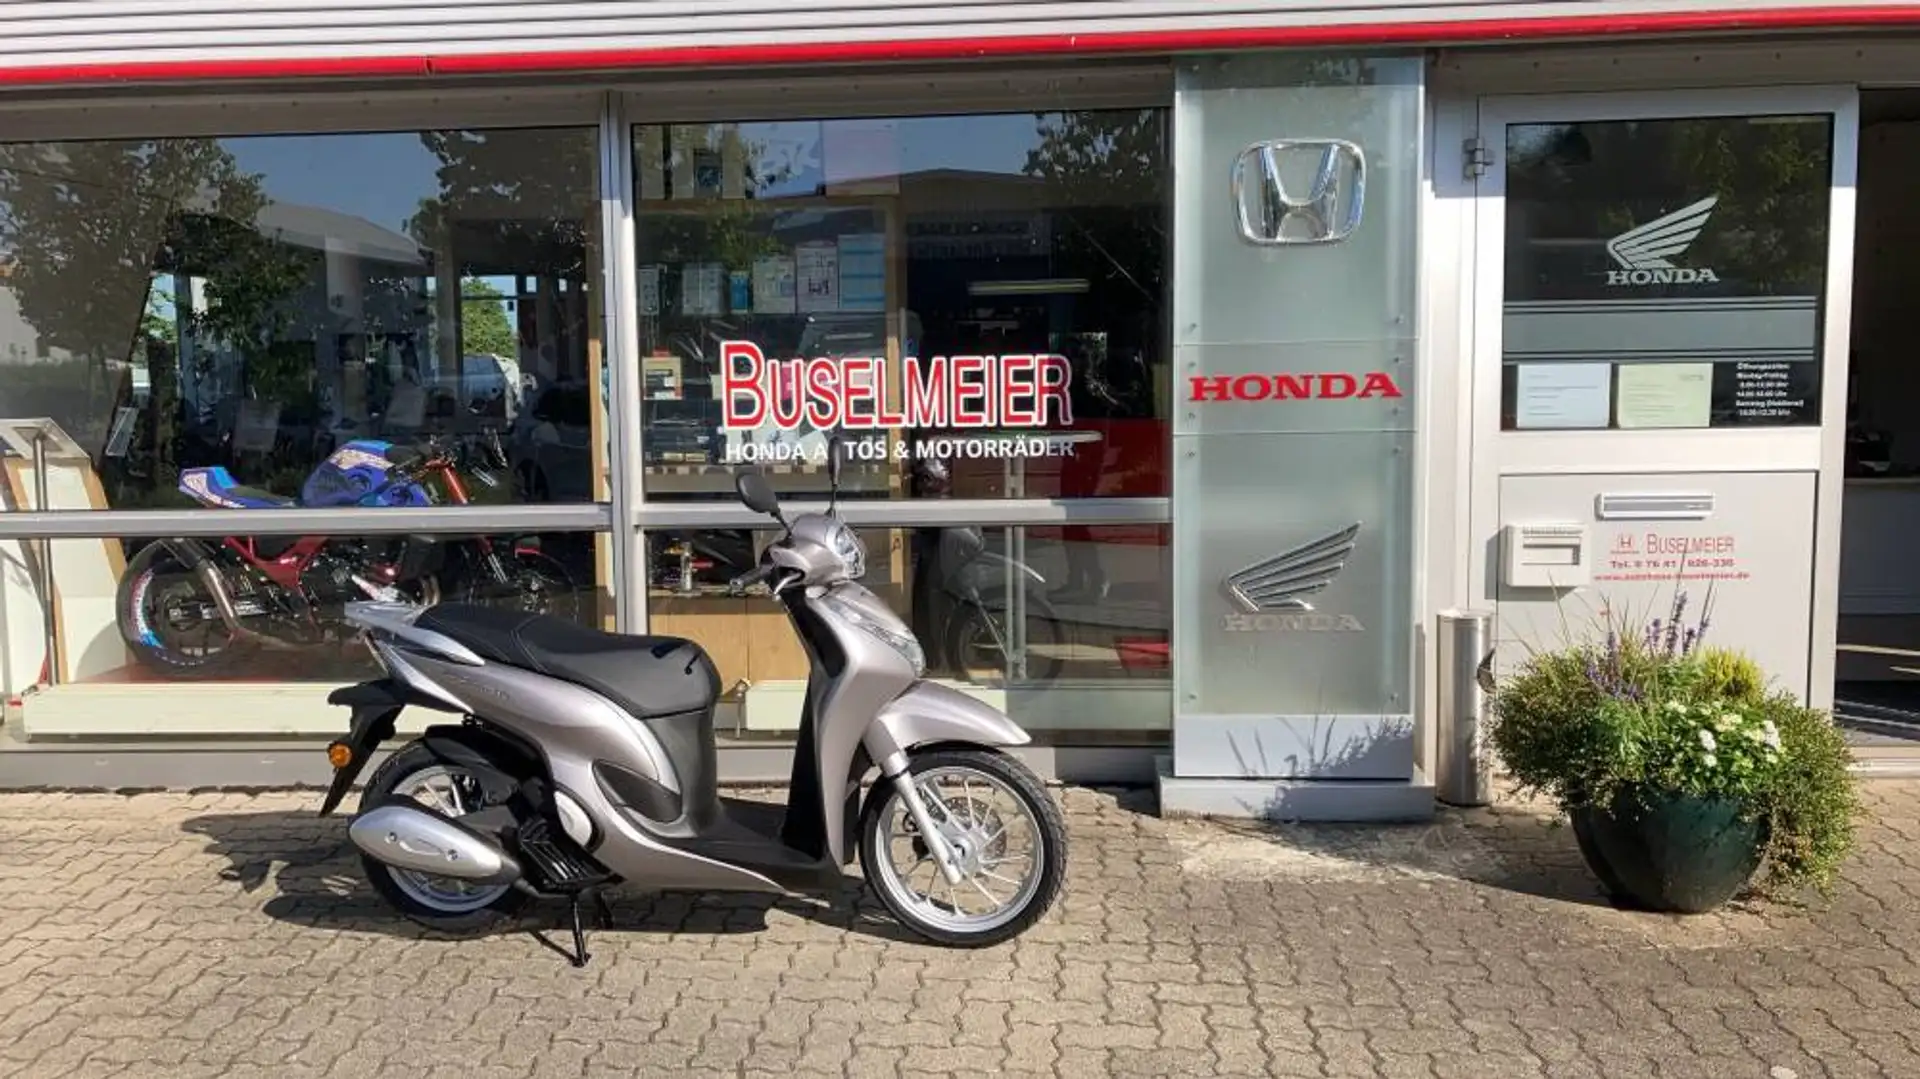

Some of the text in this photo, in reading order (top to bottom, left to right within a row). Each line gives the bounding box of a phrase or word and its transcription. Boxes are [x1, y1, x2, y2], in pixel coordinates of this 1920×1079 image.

[1606, 268, 1720, 285] HONDA
[720, 340, 1073, 430] BUSELMEIER
[1189, 373, 1402, 401] HONDA
[726, 434, 1074, 461] HONDA ATOS & MOTORRÄDER
[1224, 614, 1366, 632] HONDA
